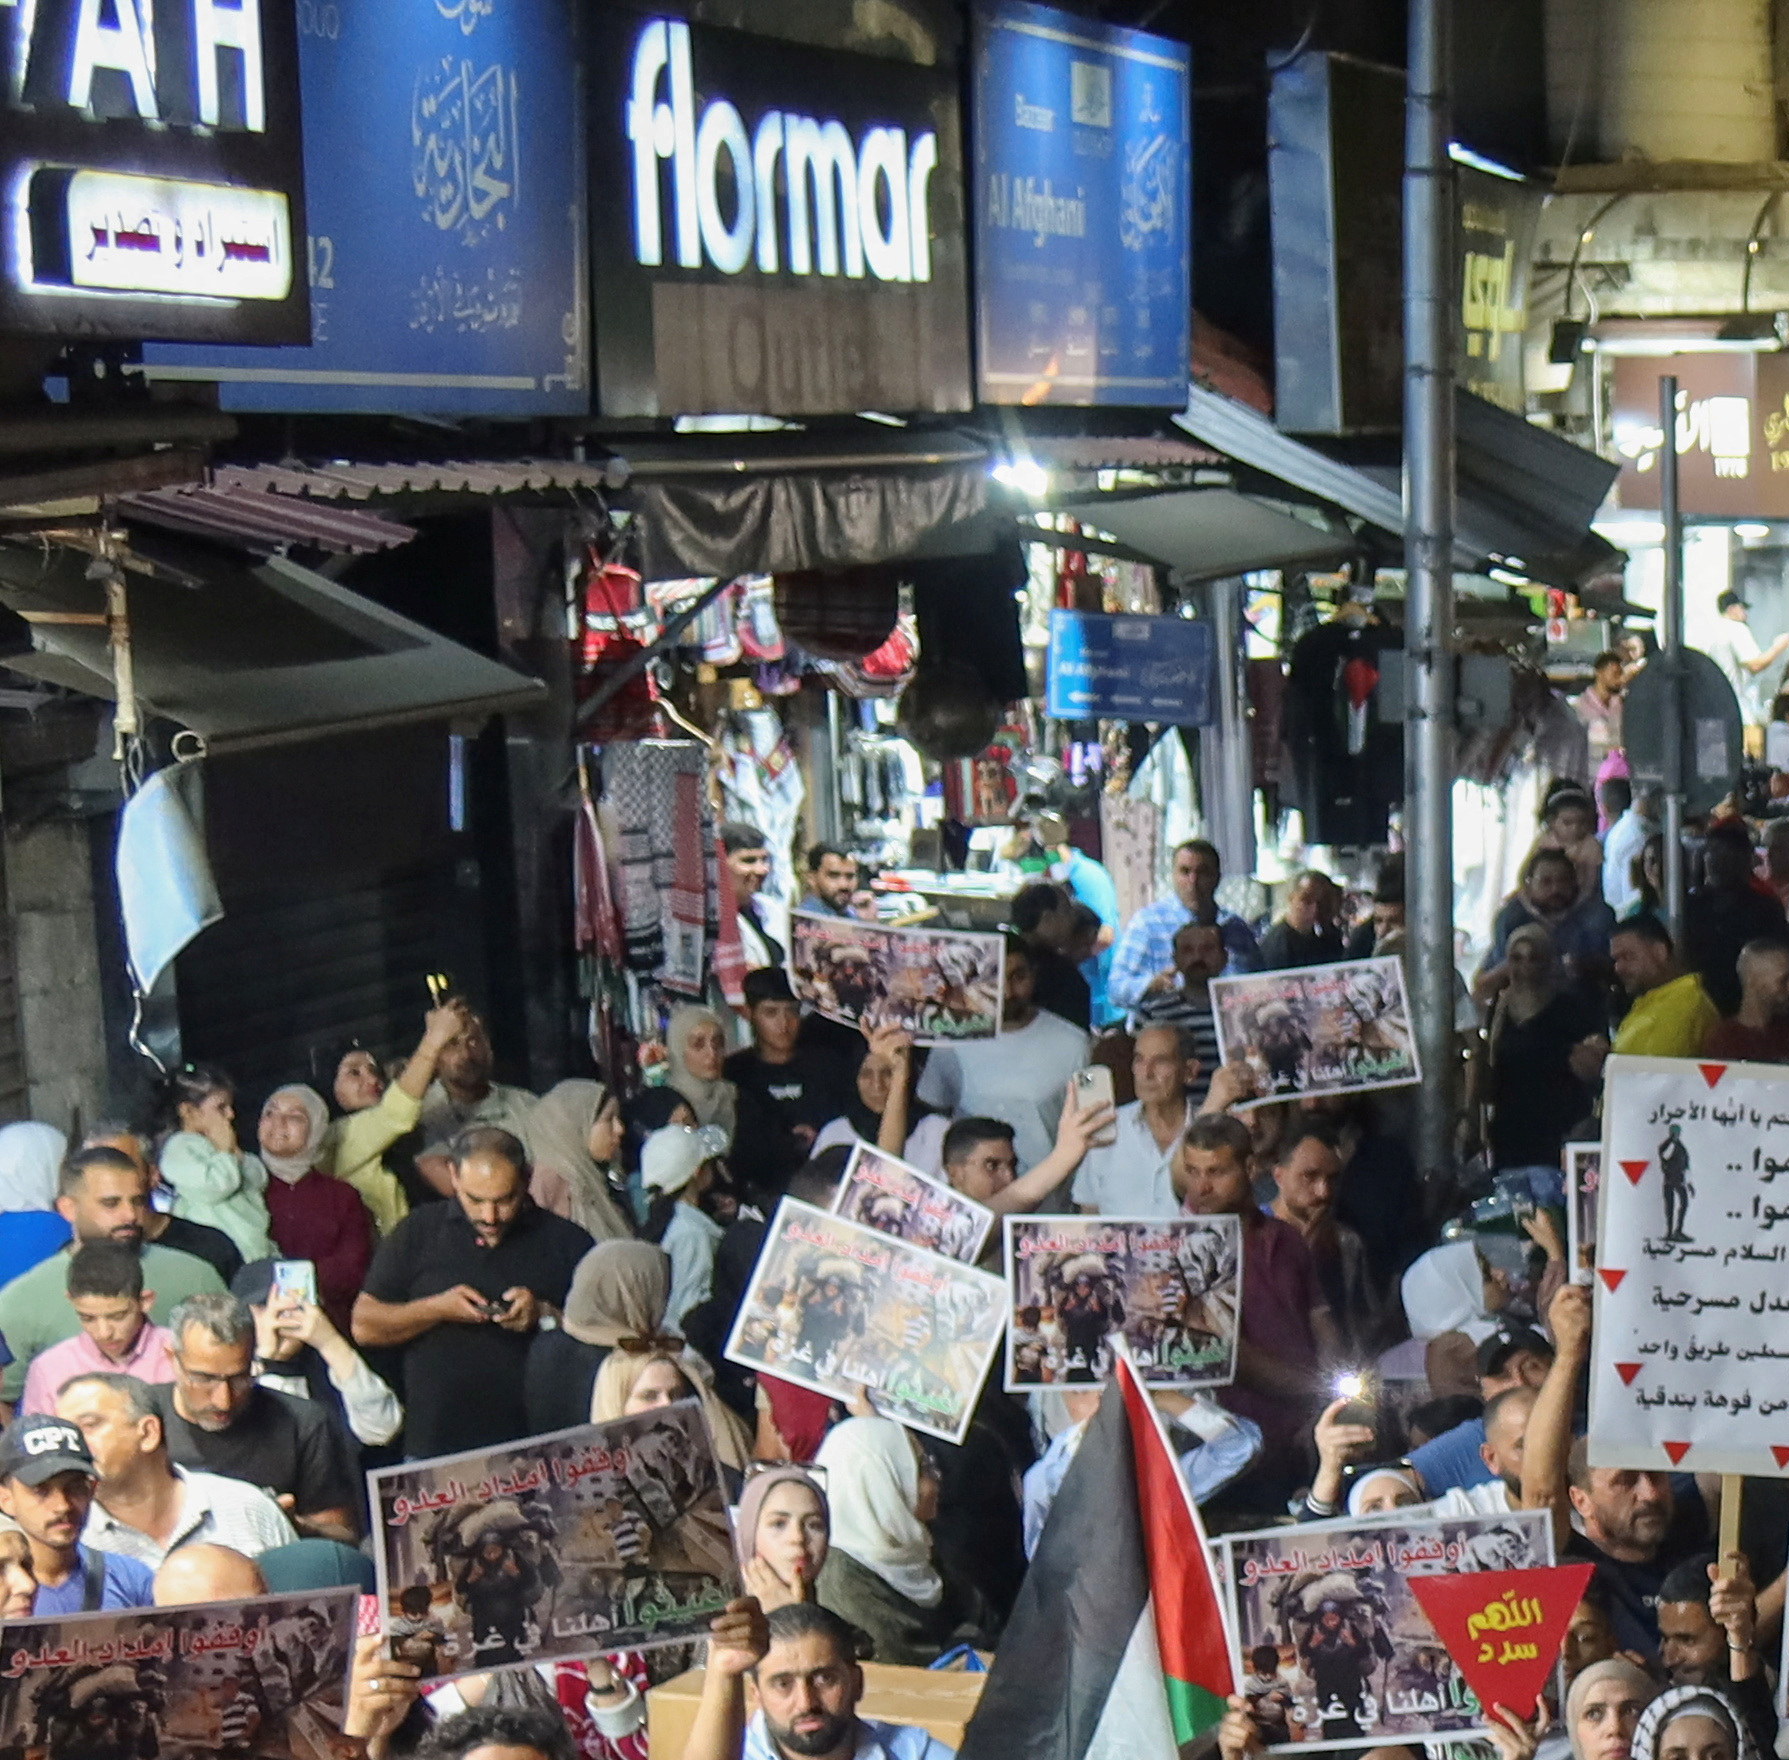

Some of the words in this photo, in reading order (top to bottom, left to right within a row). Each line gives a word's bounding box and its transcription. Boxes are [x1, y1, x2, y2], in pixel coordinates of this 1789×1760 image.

[627, 17, 937, 283] flormar
[1649, 1103, 1706, 1124] الأحرار
[1750, 1107, 1761, 1126] يا
[1723, 1244, 1786, 1266] السلام
[1652, 1286, 1740, 1314] مسرحية
[1635, 1385, 1697, 1410] بندقية
[1703, 1389, 1752, 1415] فوهة
[1758, 1398, 1788, 1415] من
[22, 1425, 82, 1456] CPT
[551, 1439, 637, 1485] أوقفوا
[386, 1477, 475, 1528] العدو
[1317, 1545, 1383, 1575] إمداد
[1387, 1531, 1468, 1572] أوقفوا
[1239, 1550, 1310, 1587] العدو
[179, 1618, 270, 1660] أوقفوا
[2, 1640, 103, 1679] العدو
[1292, 1690, 1349, 1729] غزة
[1386, 1682, 1447, 1718] أهلنا
